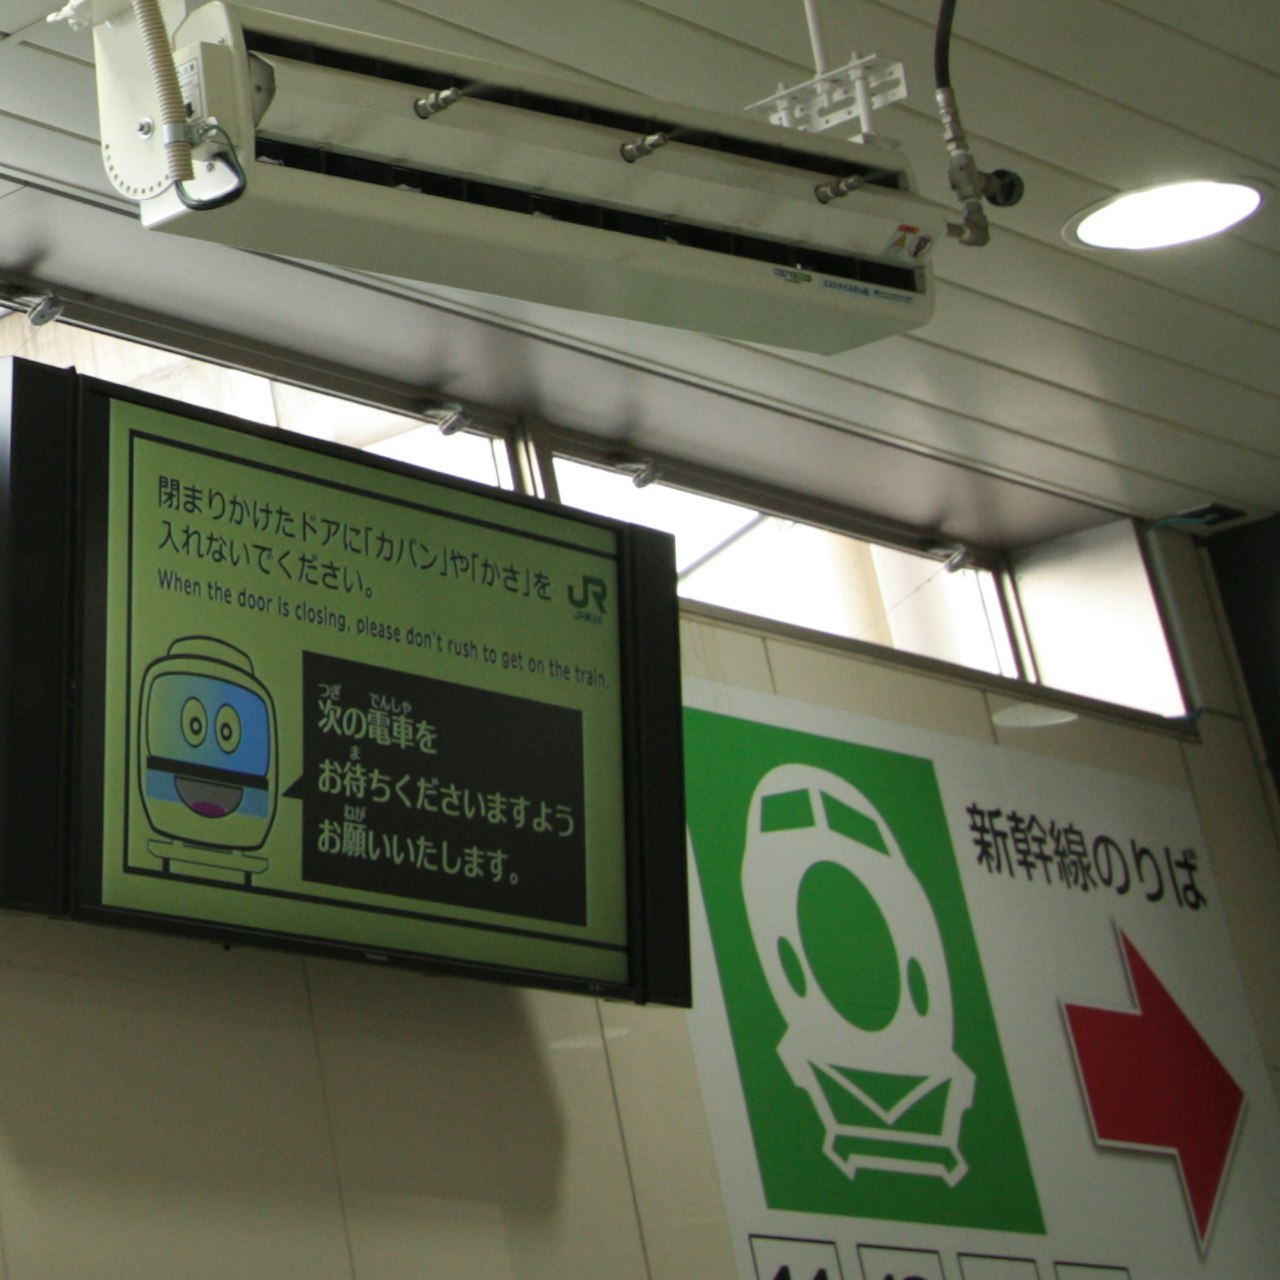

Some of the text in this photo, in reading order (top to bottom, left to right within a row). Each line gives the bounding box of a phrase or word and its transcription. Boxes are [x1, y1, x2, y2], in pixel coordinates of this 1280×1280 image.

[158, 474, 553, 602] 閉まりかけたドアに「カバン」や「かさ」を
[158, 519, 374, 600] 入れないでください。
[157, 568, 610, 689] When the door is closing, please don't rush to get on the train.
[567, 574, 608, 615] JR
[317, 698, 438, 755] 次の電車を
[317, 757, 575, 838] お待ちくださいますよう
[317, 819, 520, 886] お願いいたします。
[965, 802, 1209, 911] 新幹線のりば
